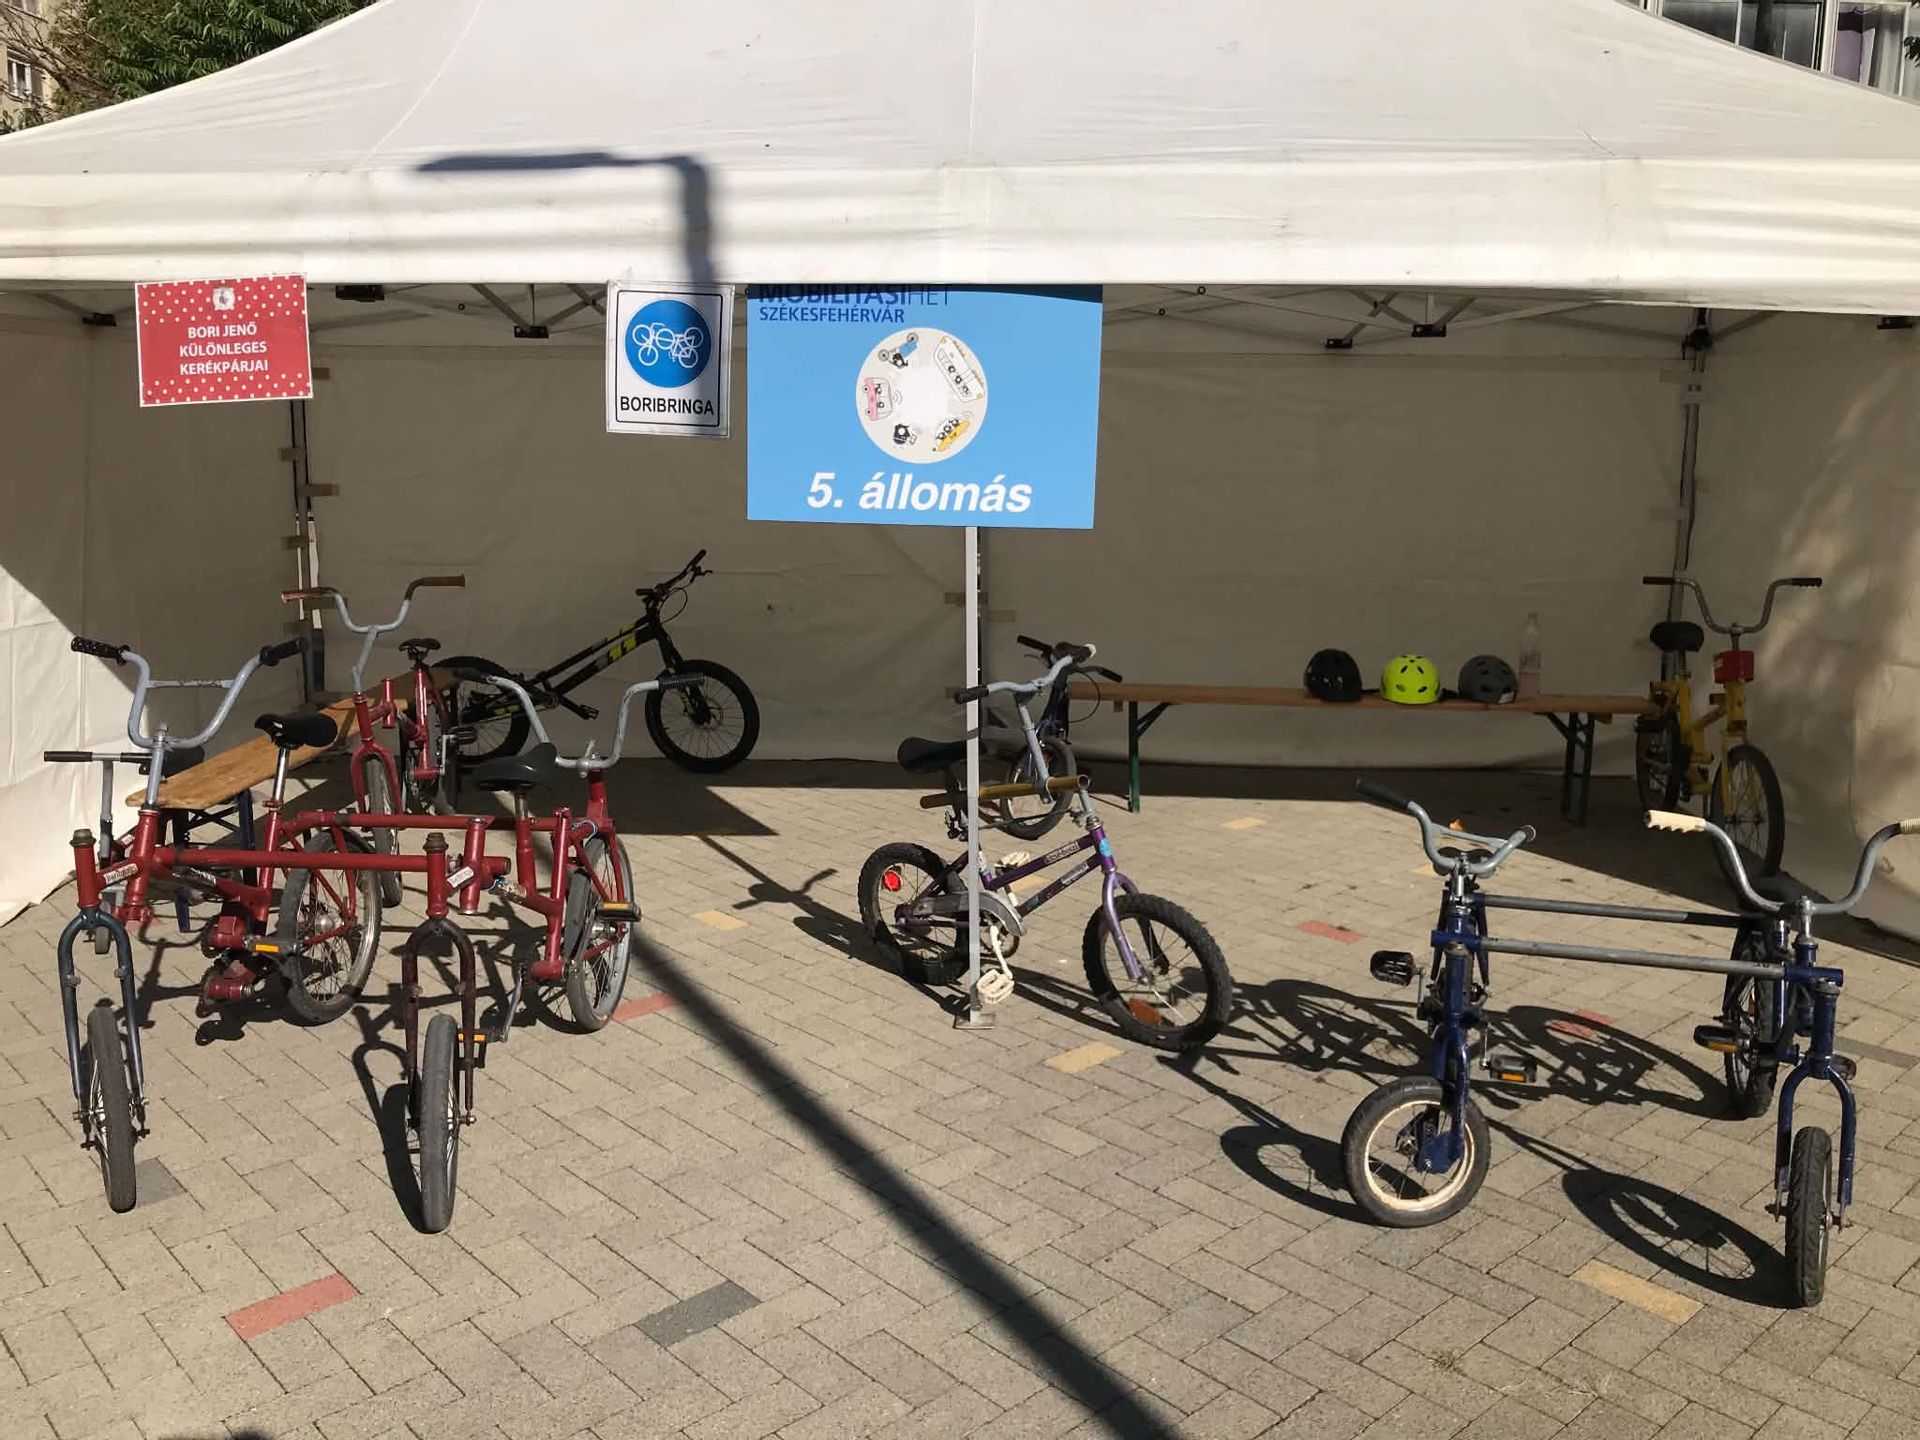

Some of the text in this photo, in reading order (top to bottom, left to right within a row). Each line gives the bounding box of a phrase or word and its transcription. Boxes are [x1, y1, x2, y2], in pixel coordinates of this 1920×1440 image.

[760, 303, 905, 323] SZÉKESFEHÉRVÁR
[188, 321, 257, 339] BORI JENŐ
[179, 341, 267, 357] KÜLÖNLEGES
[180, 359, 269, 375] KERÉKPÁRJAI
[620, 396, 715, 415] BORIBRINGA
[807, 472, 1033, 513] 5. állomás
